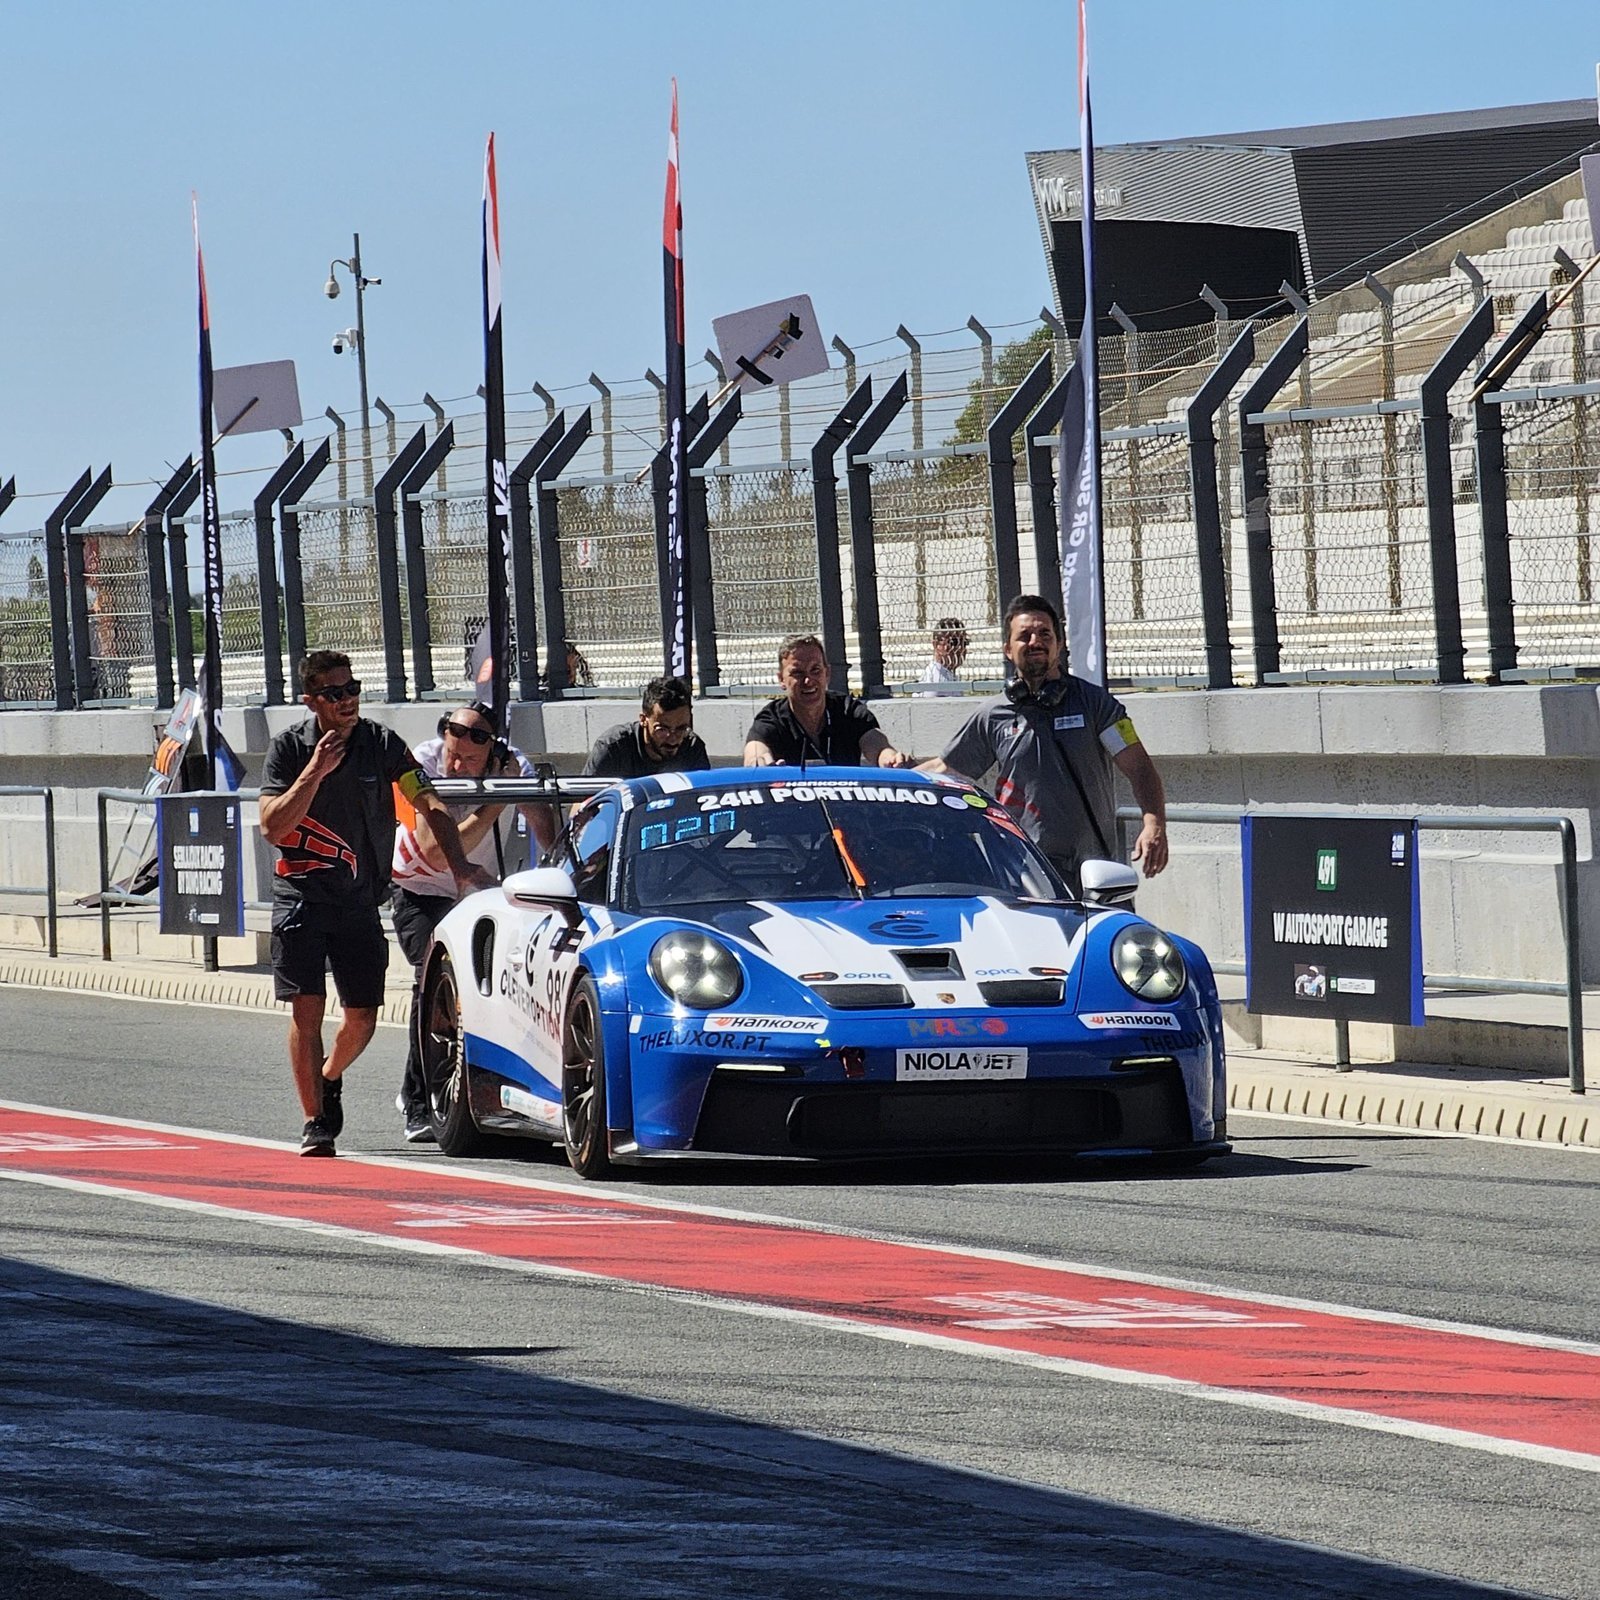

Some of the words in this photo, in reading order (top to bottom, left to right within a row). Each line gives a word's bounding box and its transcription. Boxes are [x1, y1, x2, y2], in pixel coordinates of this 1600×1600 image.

[697, 789, 764, 812] 24H
[771, 786, 938, 806] PORTIMAO
[1318, 855, 1335, 885] 491
[1273, 912, 1285, 942] W
[1285, 913, 1344, 946] AUTOSPORT
[1344, 916, 1388, 948] GARAGE
[907, 1018, 978, 1037] MRS
[640, 1030, 772, 1053] THELUXOR.PT
[904, 1052, 971, 1070] NIOLA
